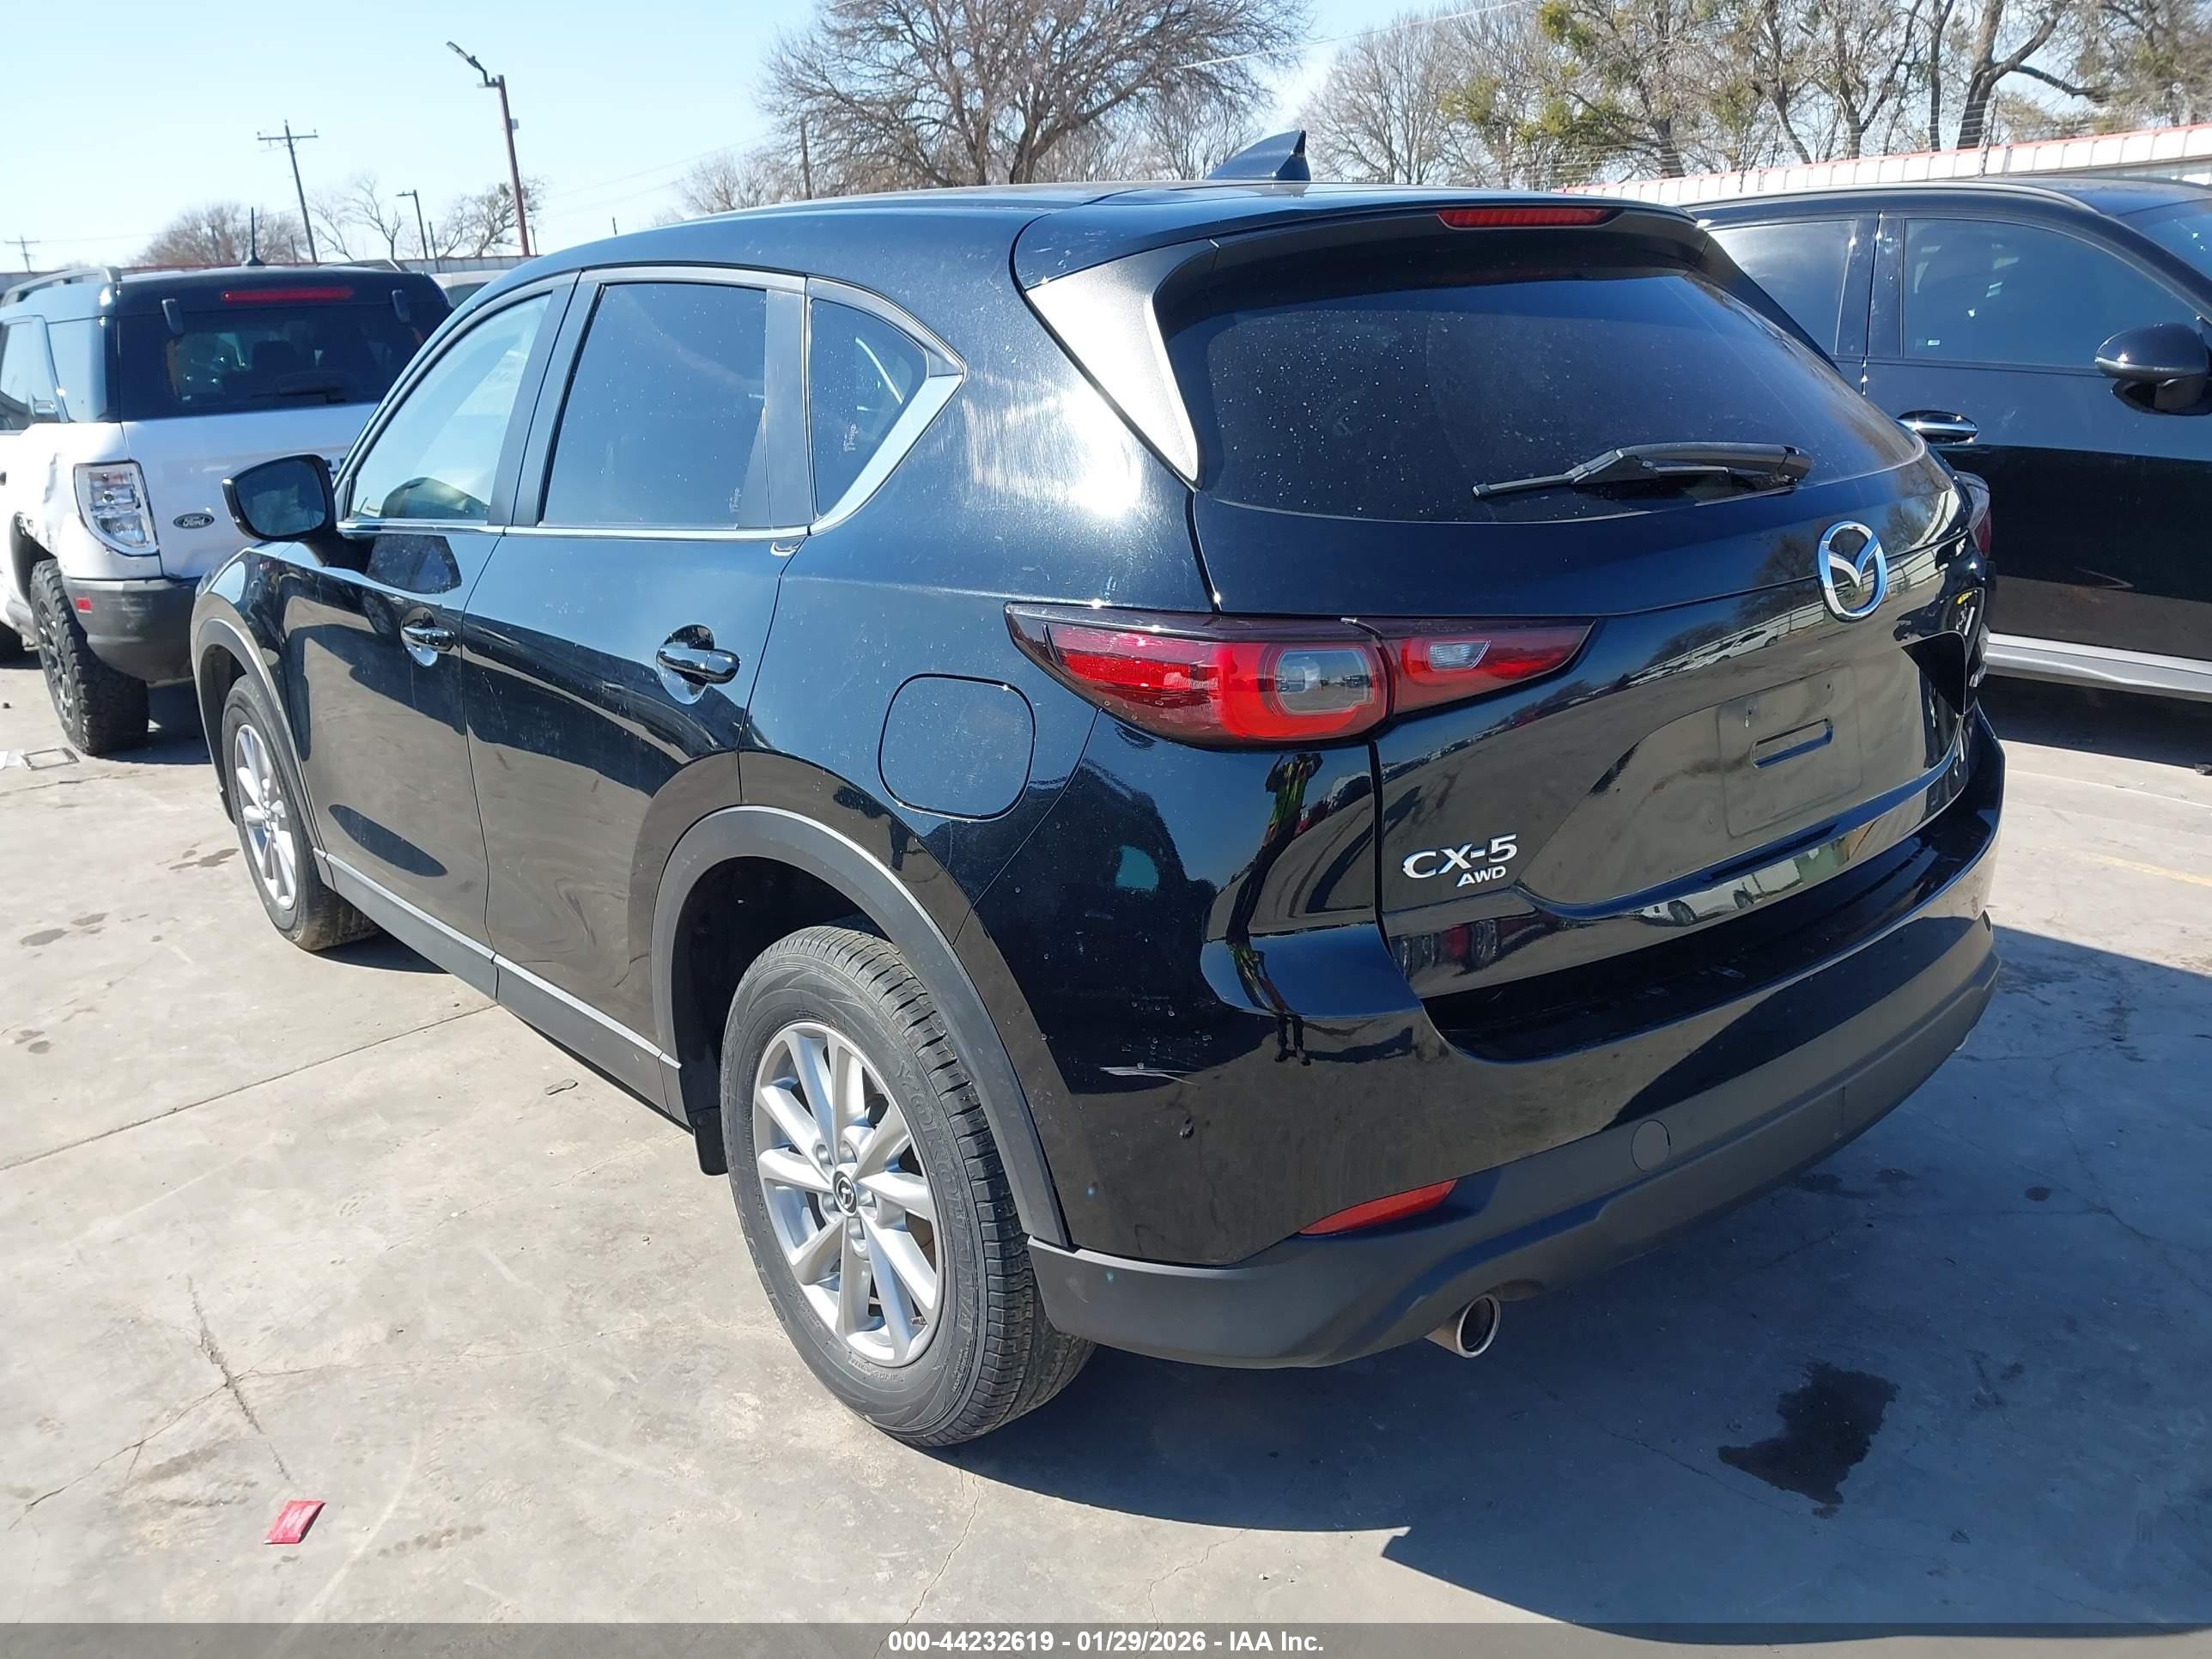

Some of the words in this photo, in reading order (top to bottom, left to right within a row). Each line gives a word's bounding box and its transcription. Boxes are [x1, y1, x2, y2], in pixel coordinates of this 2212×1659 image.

[177, 514, 210, 528] Ford
[1402, 833, 1518, 879] CX-5
[1456, 866, 1507, 888] AWD
